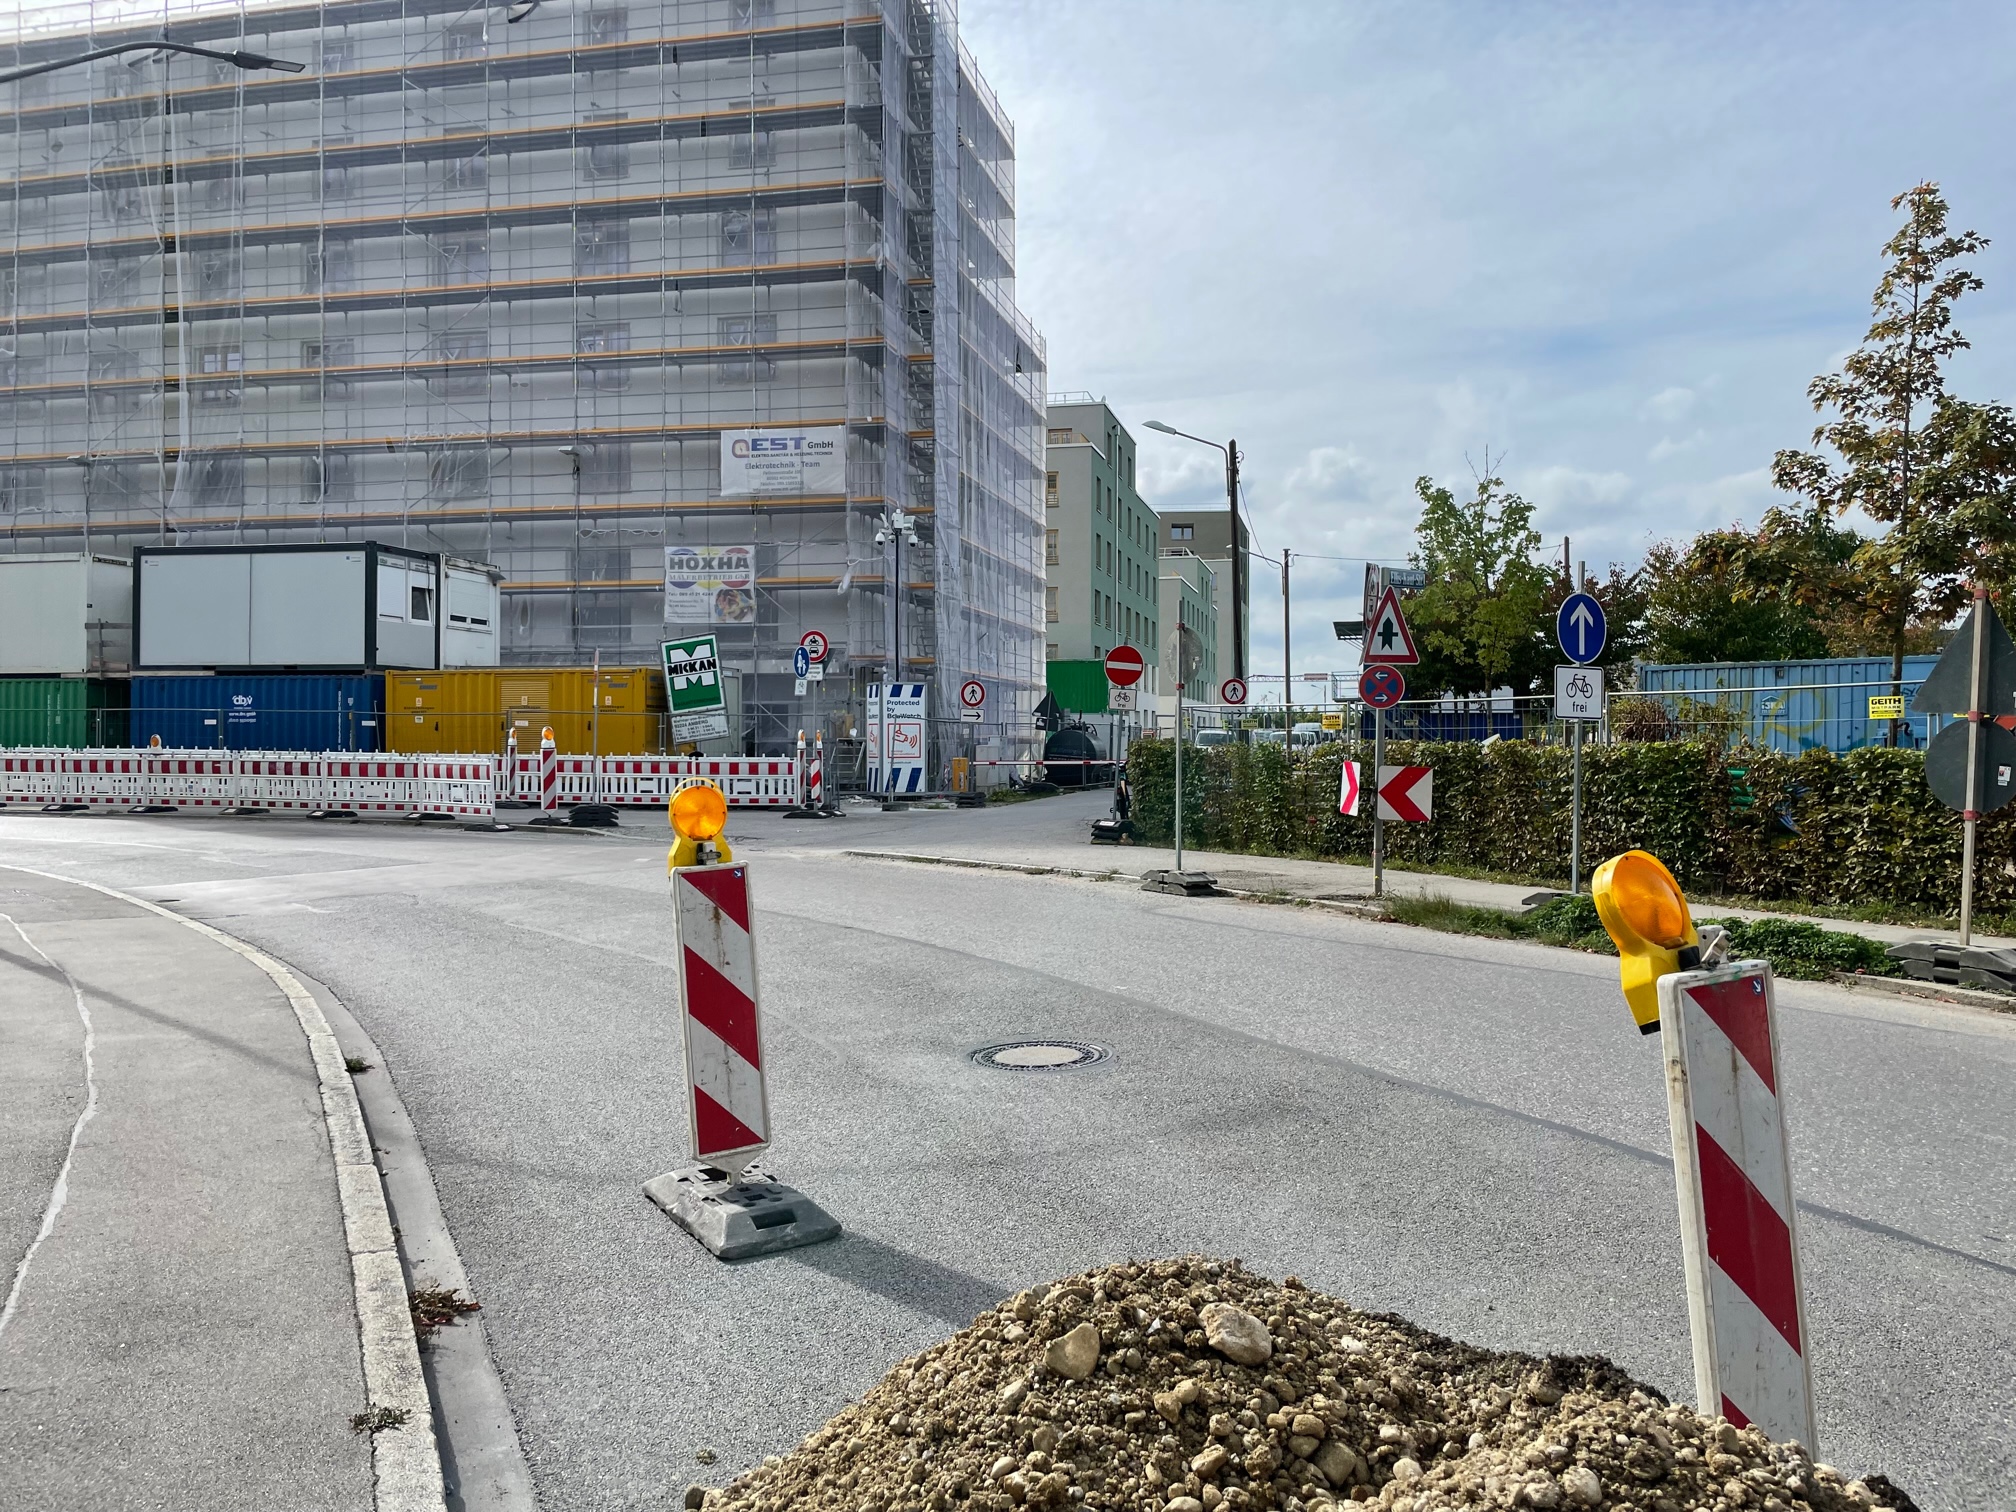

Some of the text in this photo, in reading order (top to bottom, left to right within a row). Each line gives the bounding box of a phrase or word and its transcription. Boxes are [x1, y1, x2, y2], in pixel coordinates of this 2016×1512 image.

[807, 441, 834, 449] GmbH
[745, 460, 796, 470] Elektrotechnik
[669, 557, 750, 570] HOXHA
[667, 658, 717, 676] MICKAN
[1573, 701, 1588, 712] frei
